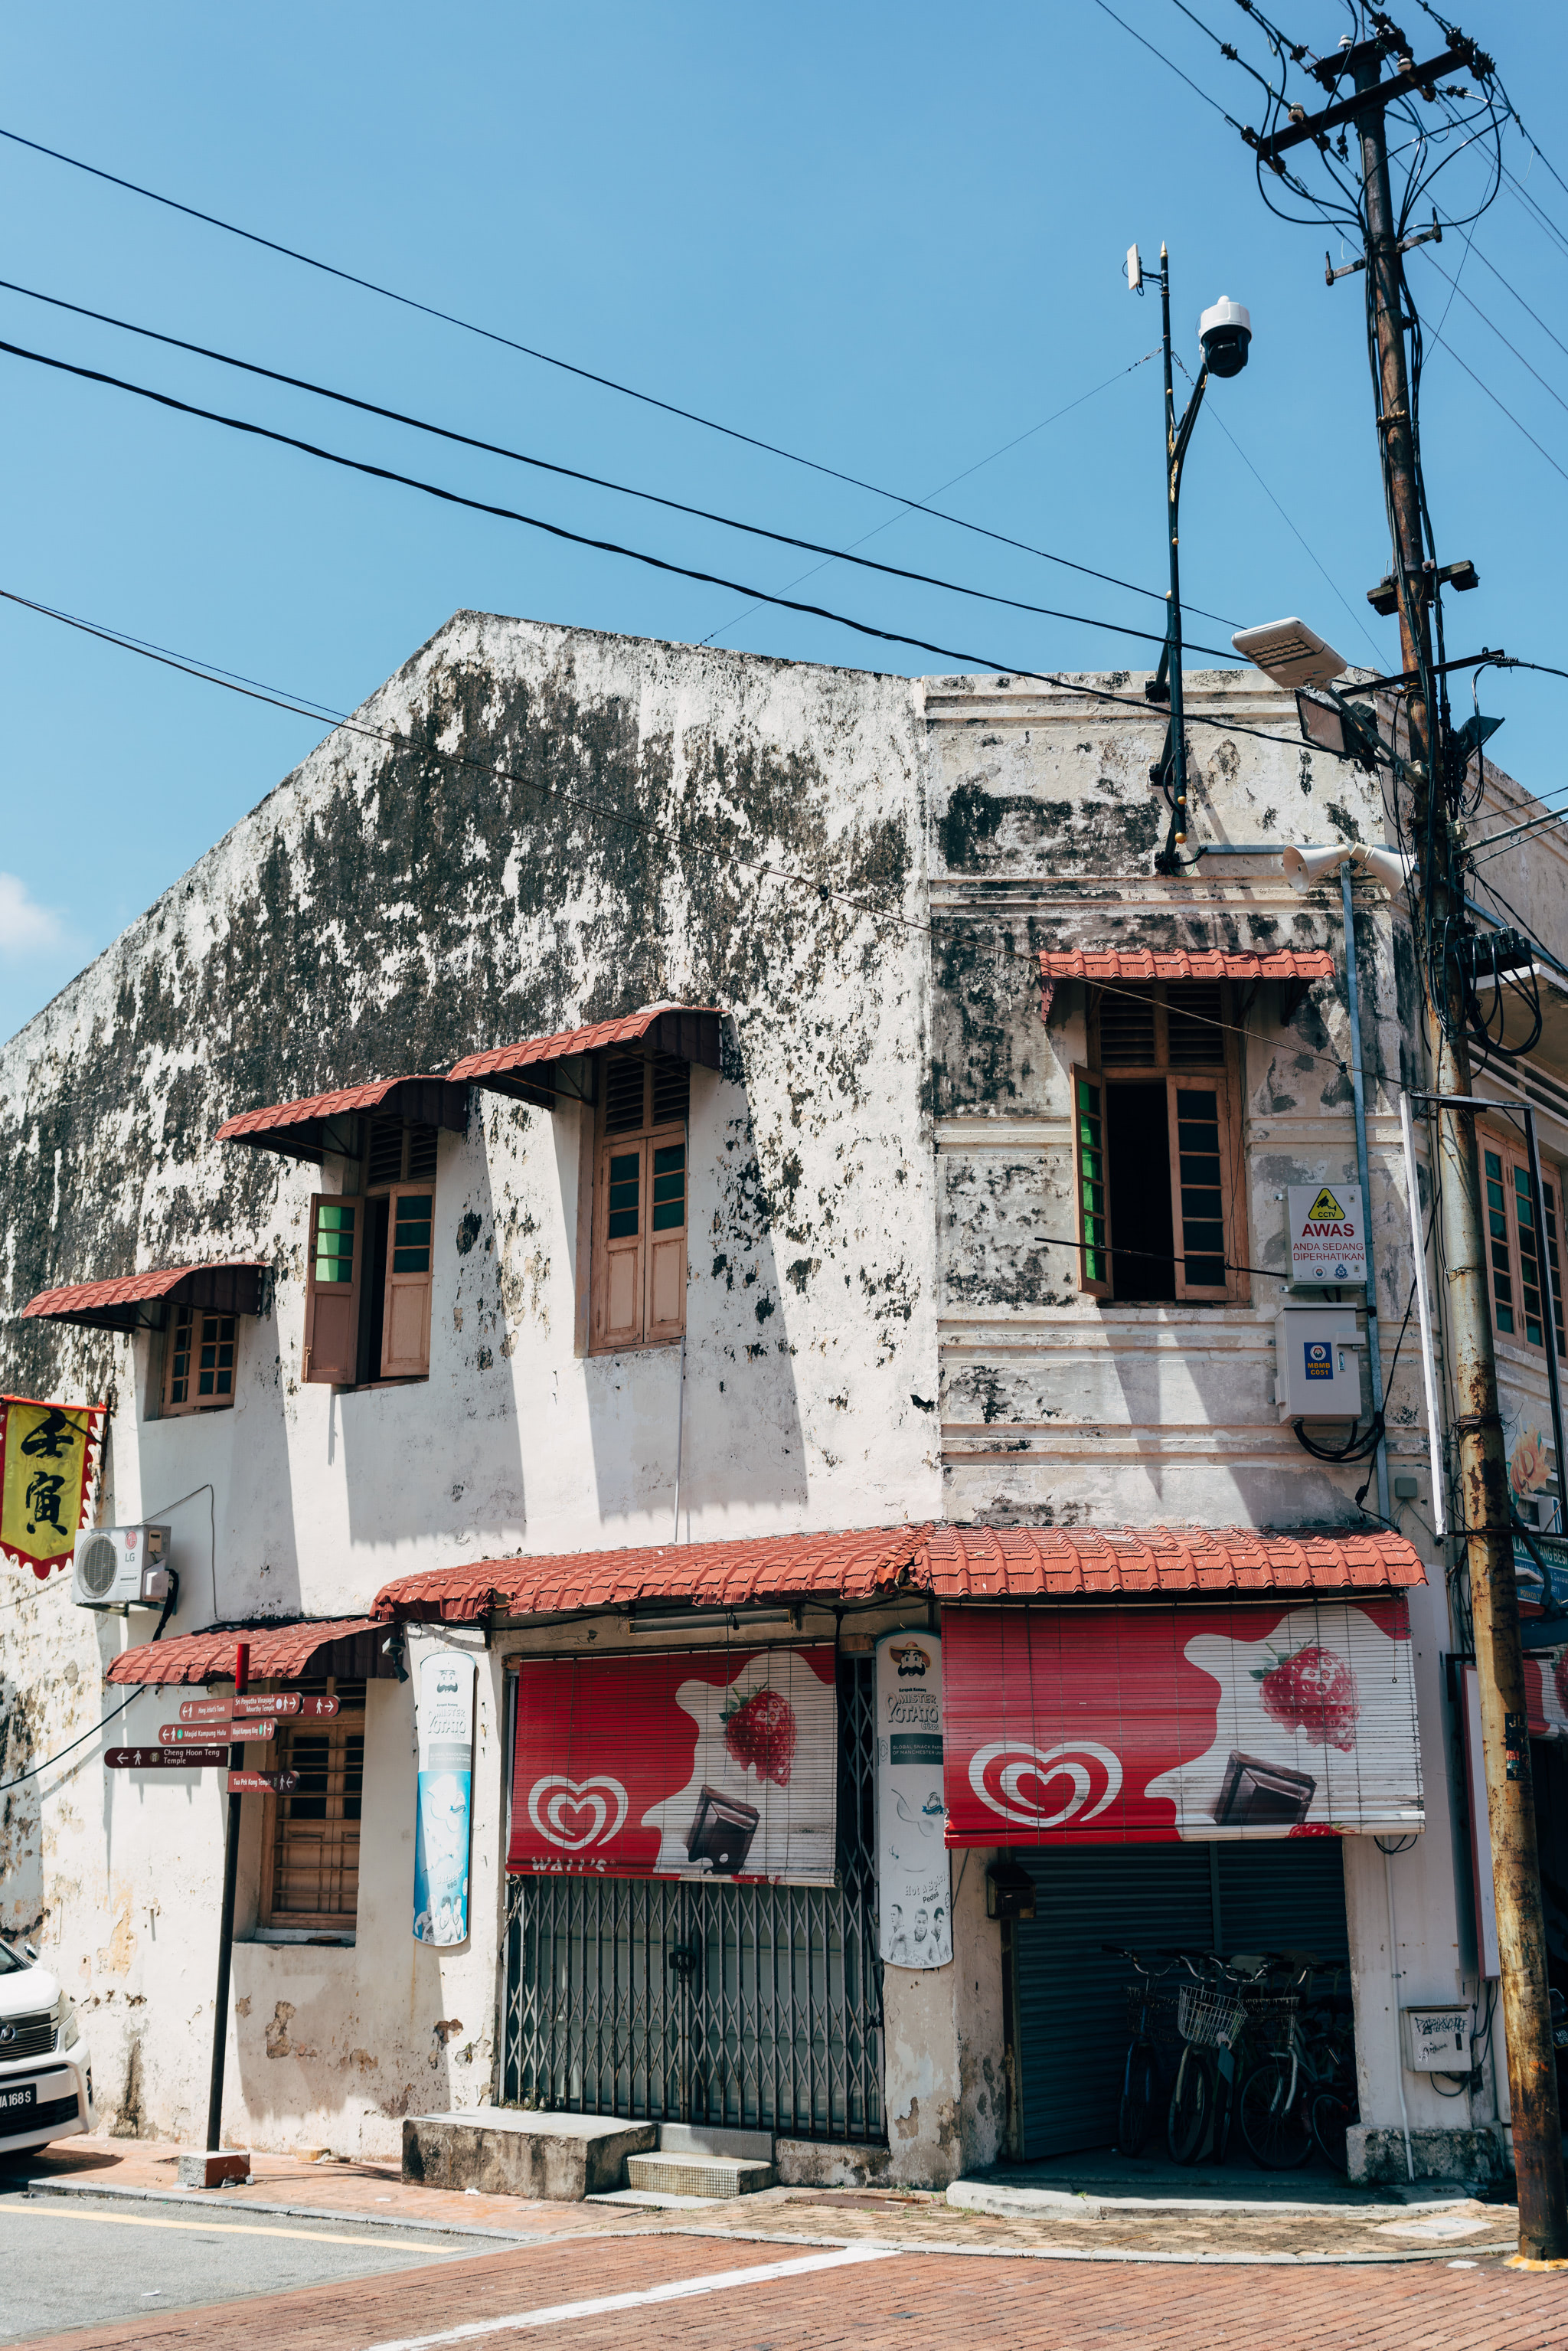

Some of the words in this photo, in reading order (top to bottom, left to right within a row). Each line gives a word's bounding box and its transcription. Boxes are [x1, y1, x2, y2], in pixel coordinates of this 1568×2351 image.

[1302, 1223, 1354, 1237] AWAS
[125, 1552, 135, 1562] LG
[898, 1694, 936, 1704] MISTER
[262, 1704, 274, 1712] Temple
[885, 1692, 939, 1723] POTATO
[921, 1722, 939, 1731] Crisps
[164, 1748, 184, 1758] Cheng
[204, 1748, 220, 1757] Teng
[248, 1778, 257, 1787] Kong
[258, 1778, 271, 1787] Temple
[446, 1879, 458, 1890] BBQ
[905, 1885, 920, 1895] Hot
[923, 1892, 939, 1903] Pedas
